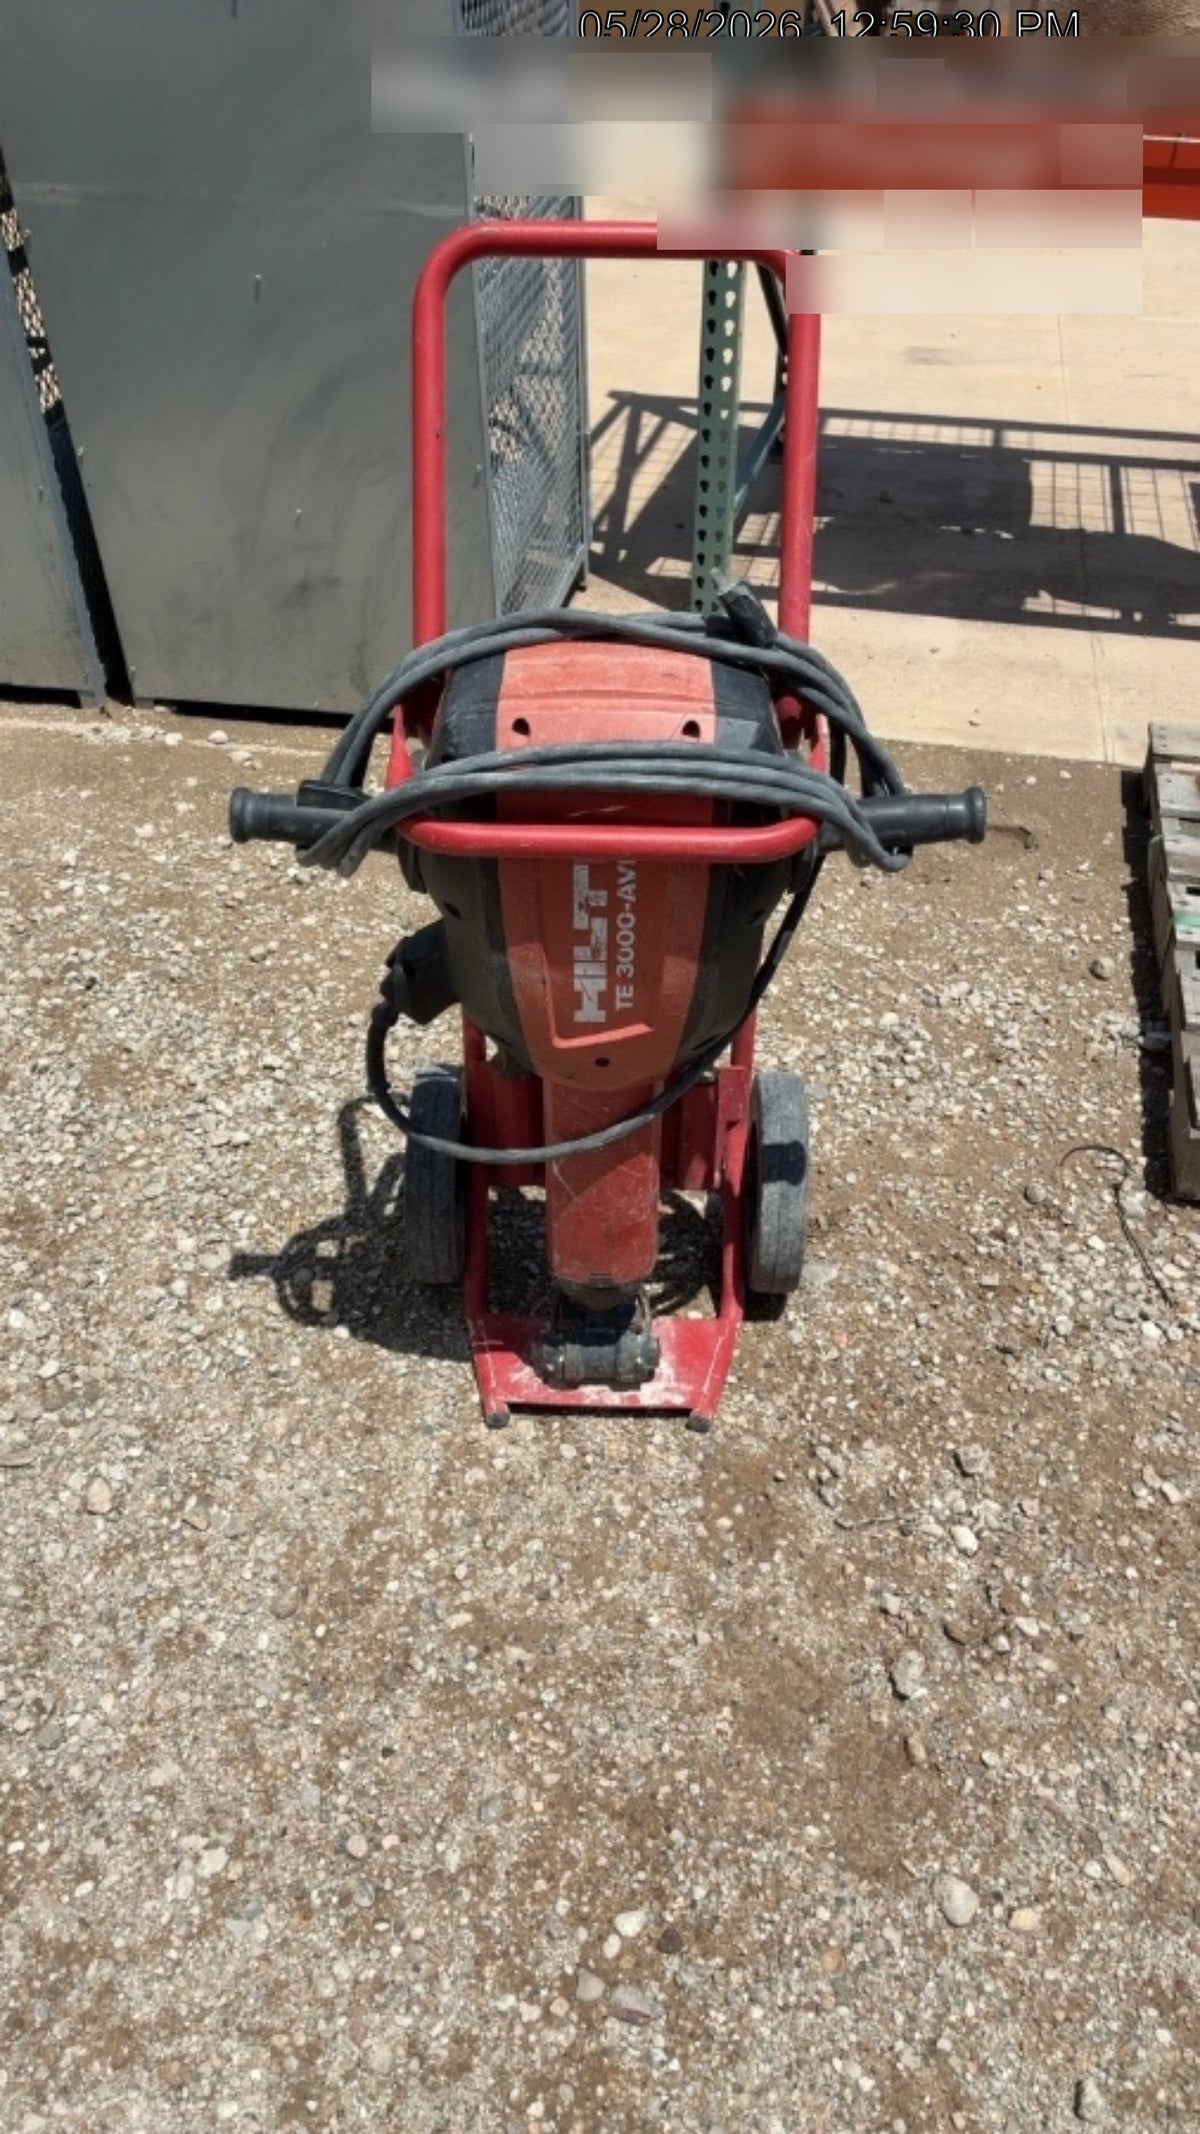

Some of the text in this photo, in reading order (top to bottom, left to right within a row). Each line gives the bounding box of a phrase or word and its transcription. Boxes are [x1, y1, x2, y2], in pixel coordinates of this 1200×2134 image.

[573, 861, 608, 1022] HILT
[616, 860, 637, 1010] TE 3000-AV
